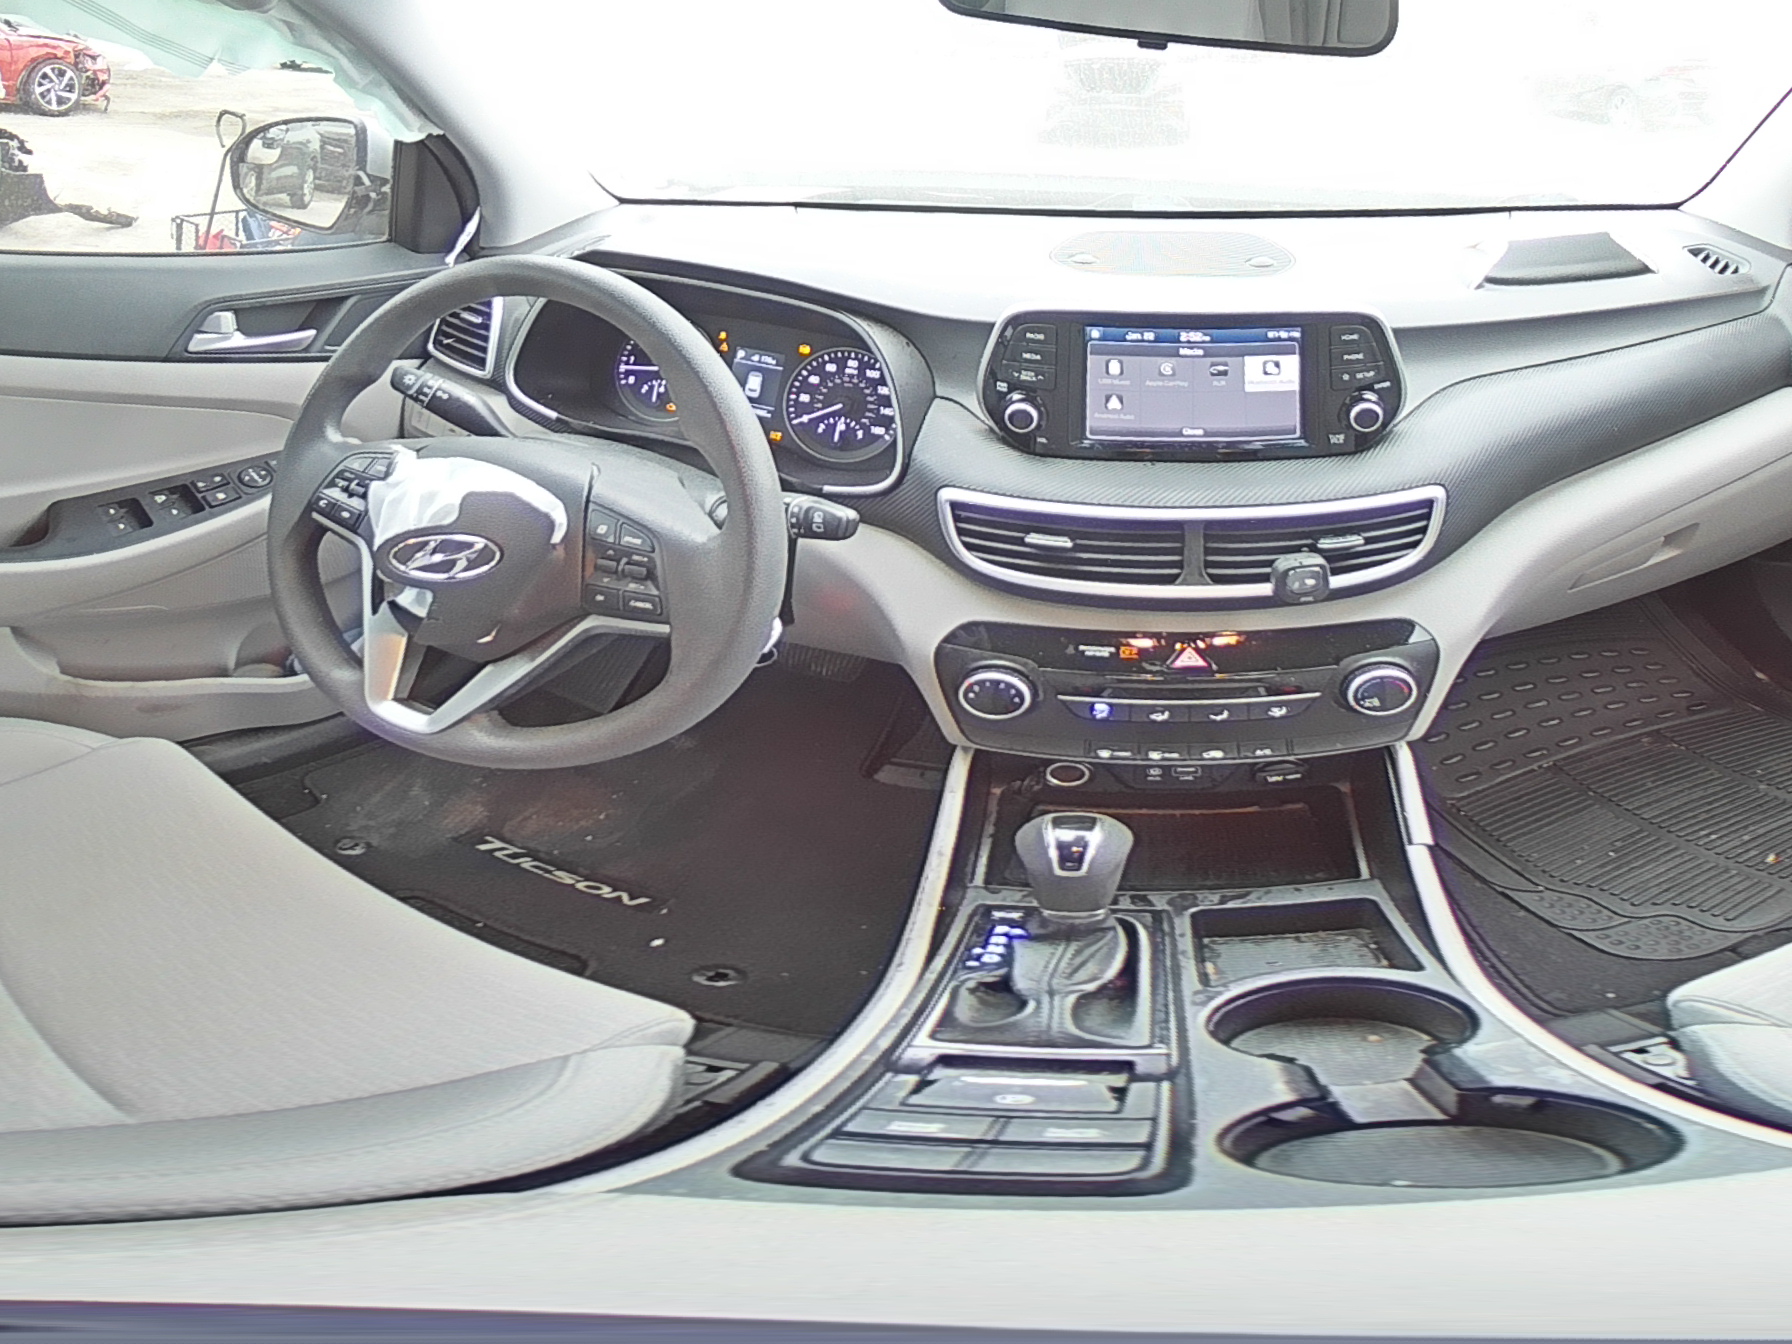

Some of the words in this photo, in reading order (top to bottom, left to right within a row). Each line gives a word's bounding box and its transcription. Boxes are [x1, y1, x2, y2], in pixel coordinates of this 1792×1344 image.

[824, 362, 837, 372] 60
[846, 358, 859, 368] 80
[807, 374, 820, 384] 40
[798, 392, 811, 403] 20
[474, 835, 651, 908] TUCSON
